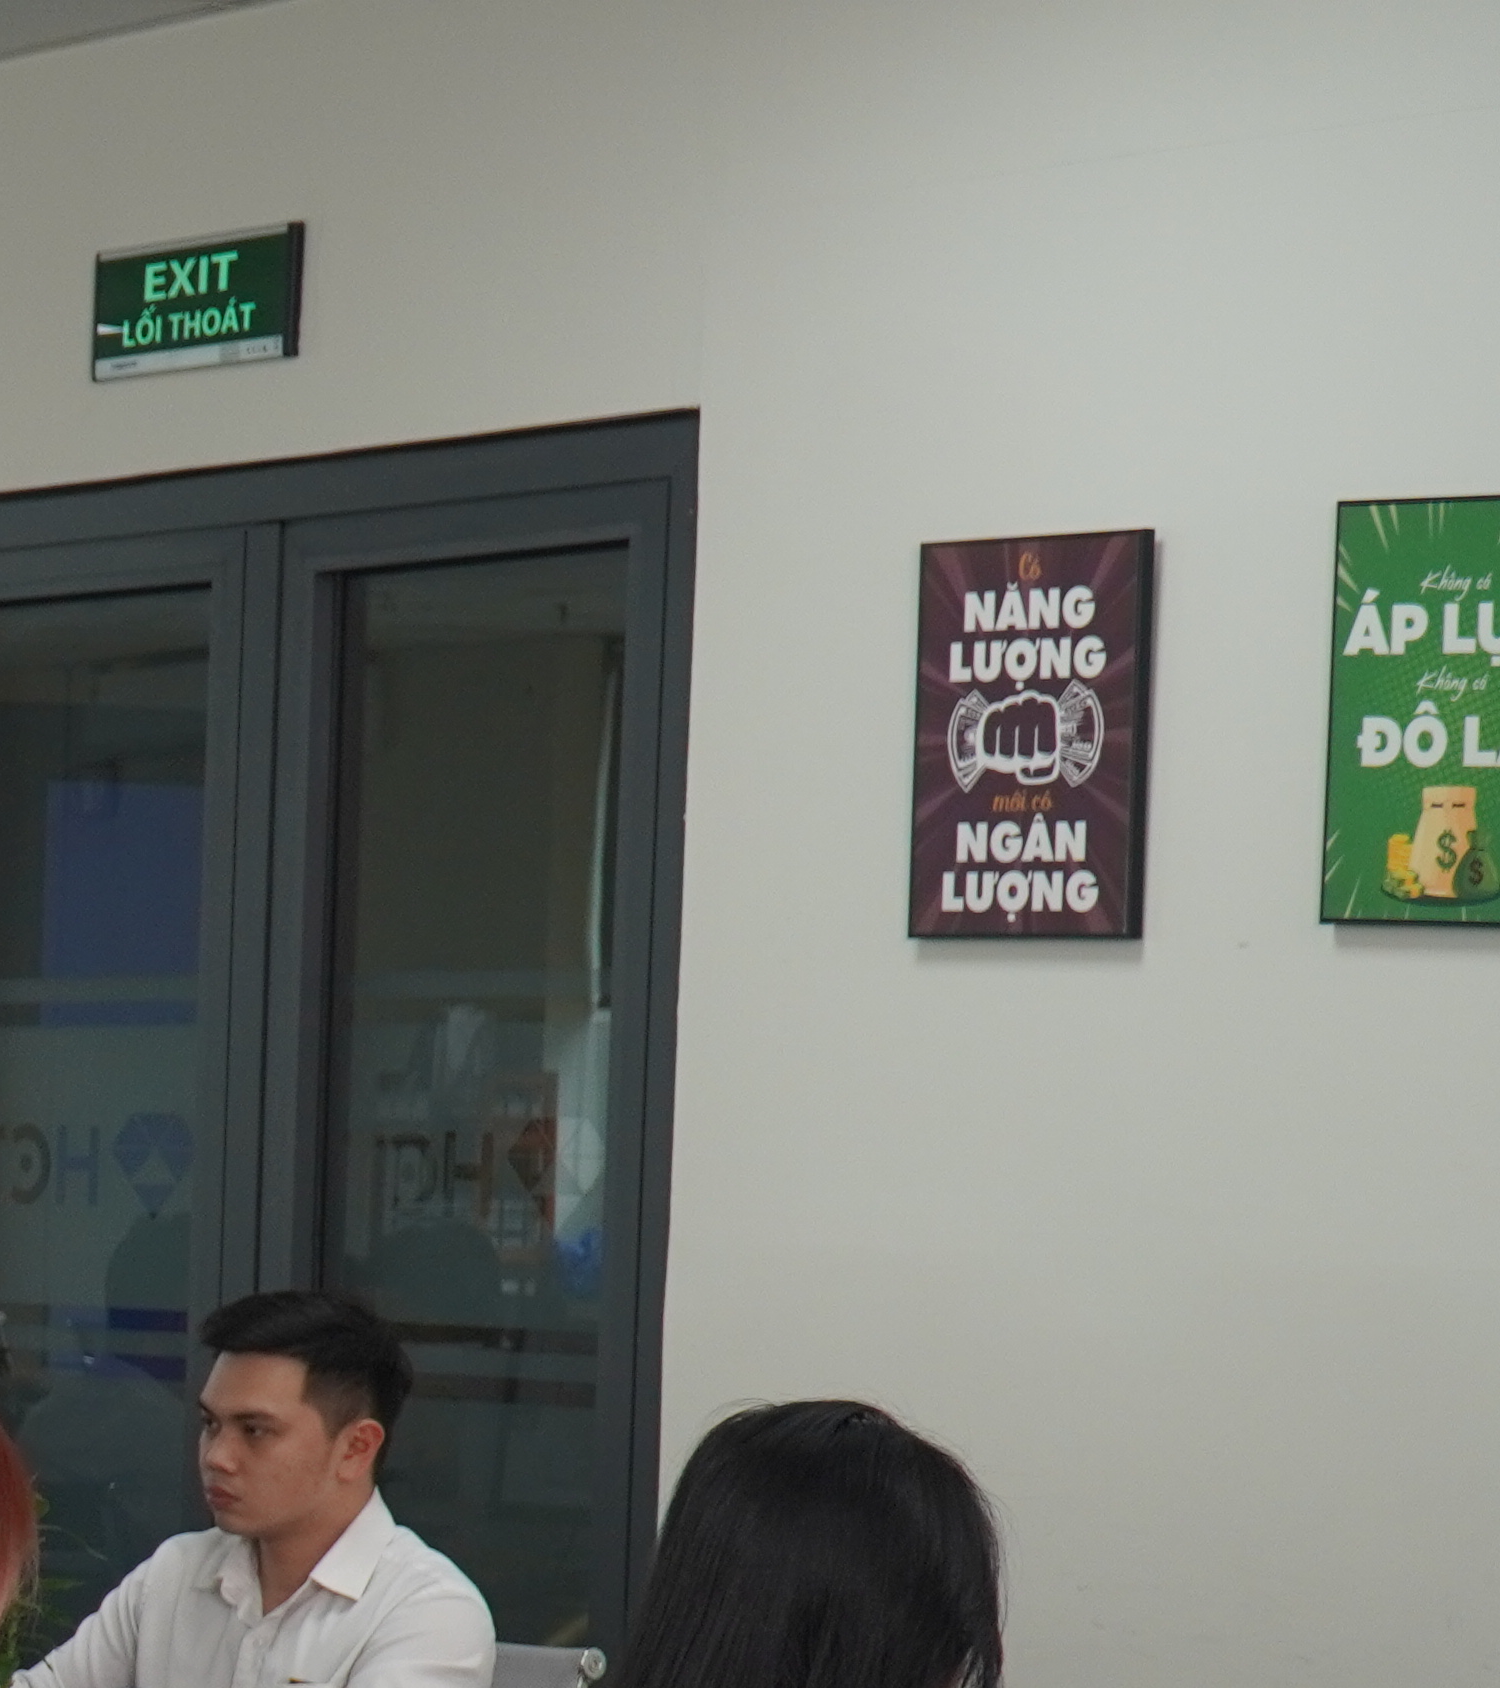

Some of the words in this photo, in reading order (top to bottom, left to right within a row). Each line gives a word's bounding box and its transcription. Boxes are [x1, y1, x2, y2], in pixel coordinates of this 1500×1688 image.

[143, 250, 239, 303] EXIT
[121, 304, 162, 349] LỐI
[168, 297, 257, 342] THOÁT
[963, 581, 1096, 633] NĂNG
[1420, 564, 1472, 601] Không
[1343, 587, 1429, 656] ÁP
[948, 634, 1107, 691] LƯỢNG
[1416, 665, 1467, 702] Không
[1357, 700, 1449, 768] ĐÔ
[956, 812, 1088, 864] NGÂN
[941, 869, 1099, 922] LƯỢNG
